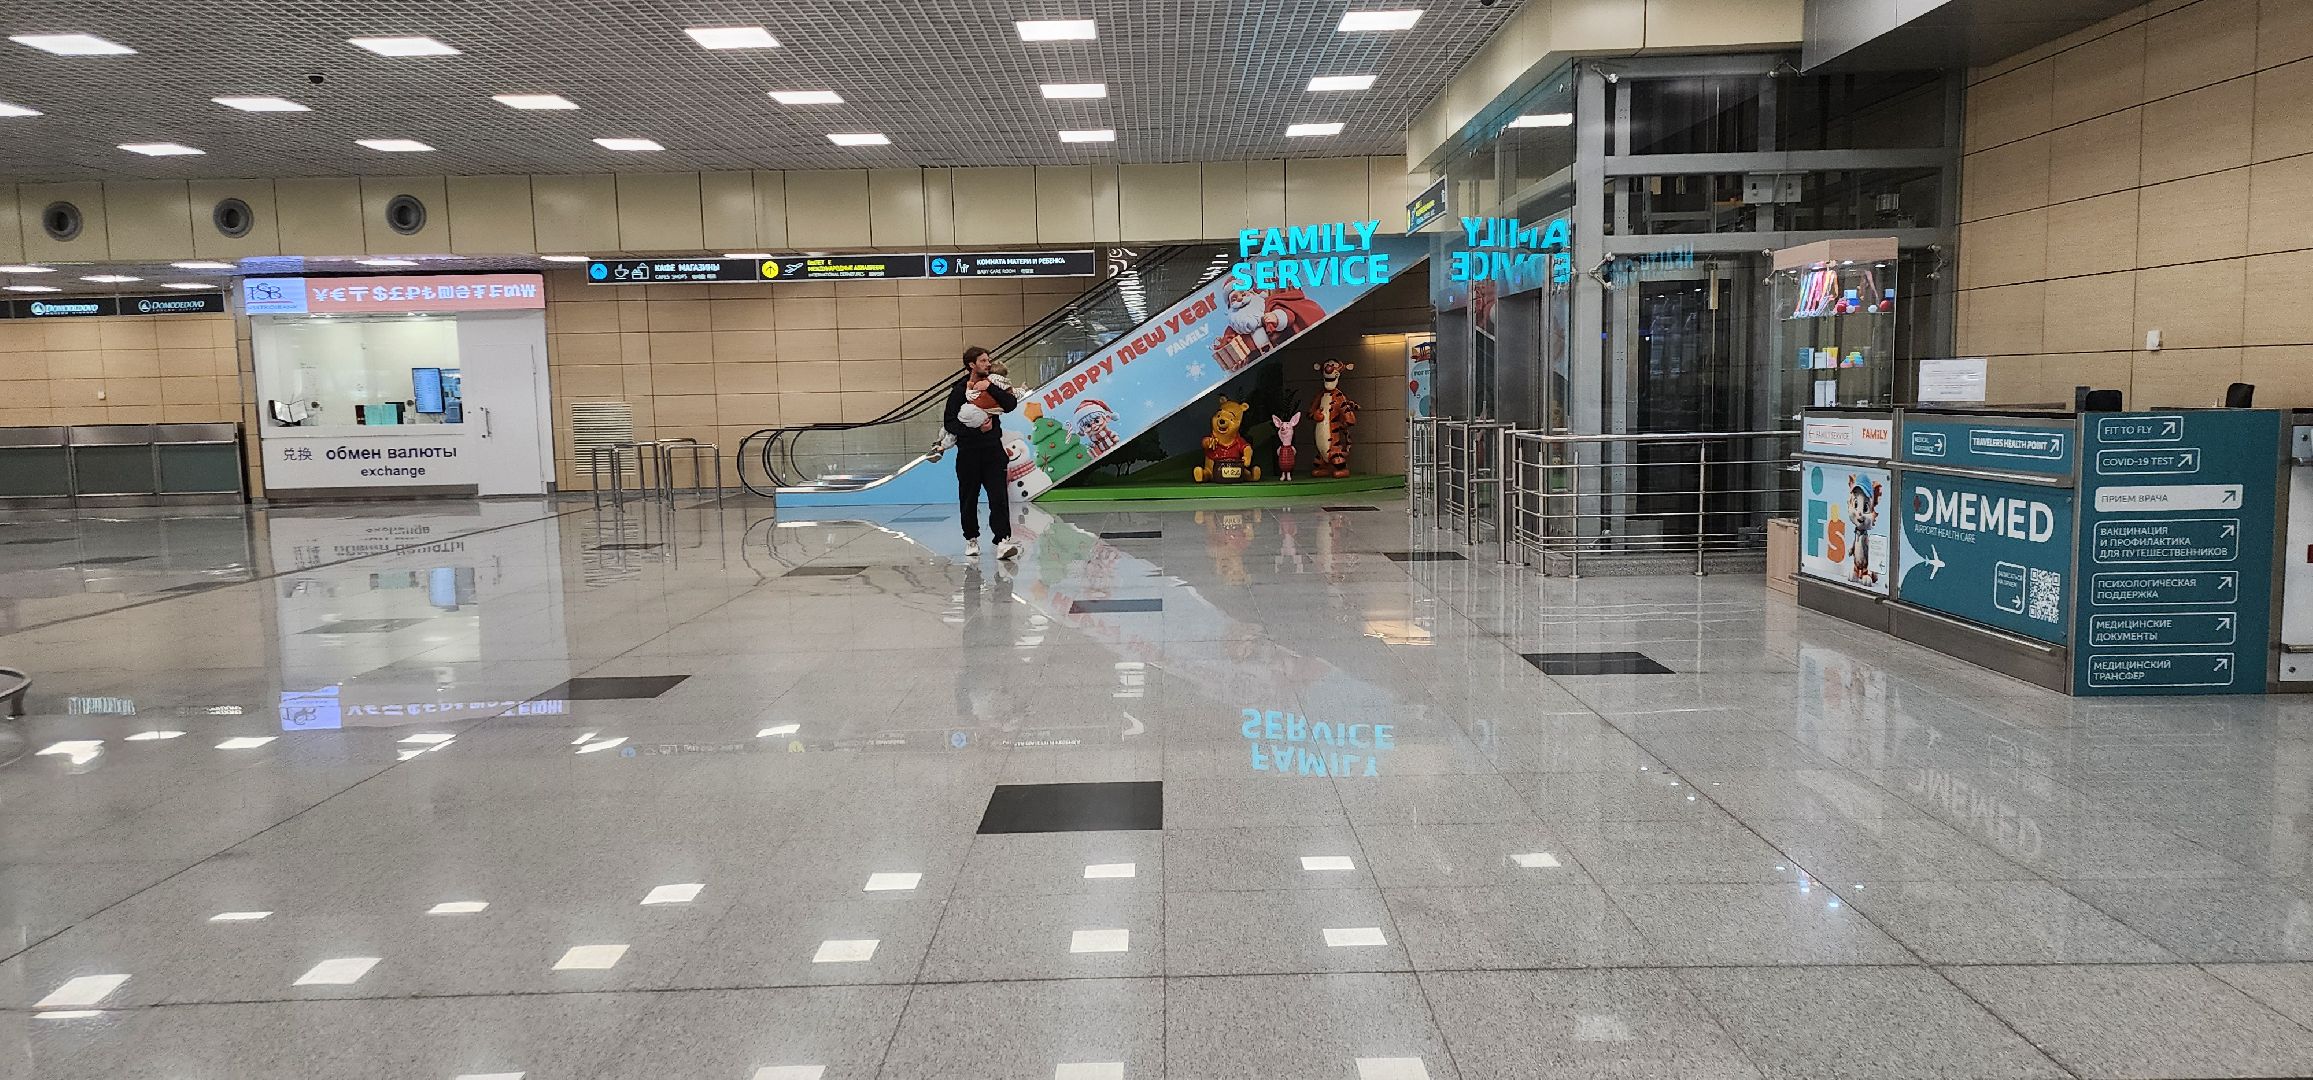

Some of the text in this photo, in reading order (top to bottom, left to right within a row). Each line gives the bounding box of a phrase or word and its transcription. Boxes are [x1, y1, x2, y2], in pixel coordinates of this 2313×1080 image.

[1239, 219, 1380, 258] FAMILY
[976, 256, 1066, 266] КОМНАТА МАТЕРИ И РЕБЕНКА
[678, 263, 720, 271] МАГАЗИНЫ
[1231, 253, 1391, 292] SERVICE
[152, 300, 205, 309] DOMODEDOVO
[2104, 425, 2153, 435] FIT TO FLY
[1973, 437, 2048, 451] TRAVELERS HEALTH POINT
[283, 447, 313, 461] 兑换
[326, 446, 457, 460] обмен валюты
[2102, 456, 2174, 466] COVID-19 TEST
[360, 466, 426, 478] exchange
[2101, 494, 2168, 503] ПРИЕМ ВРАЧА
[1914, 486, 2054, 543] DMEMED
[1914, 523, 1976, 544] AIRPORT HEALTH CARE
[2100, 527, 2168, 537] ВАКЦИНАЦИЯ
[2100, 537, 2191, 547] И ПРОФИЛАКТИКА
[2099, 547, 2228, 559] ДЛЯ ПУТЕШЕСТВЕННИКОВ
[2098, 578, 2197, 588] ПСИХОЛОГИЧЕСКАЯ
[2097, 590, 2159, 600] ПОДДЕРЖКА
[2096, 619, 2173, 630] МЕДИЦИНСКИЕ
[2095, 632, 2158, 642] ДОКУМЕНТЫ
[2093, 660, 2171, 671] МЕДИЦИНСКИЙ
[2093, 672, 2145, 681] ТРАНСФЕР
